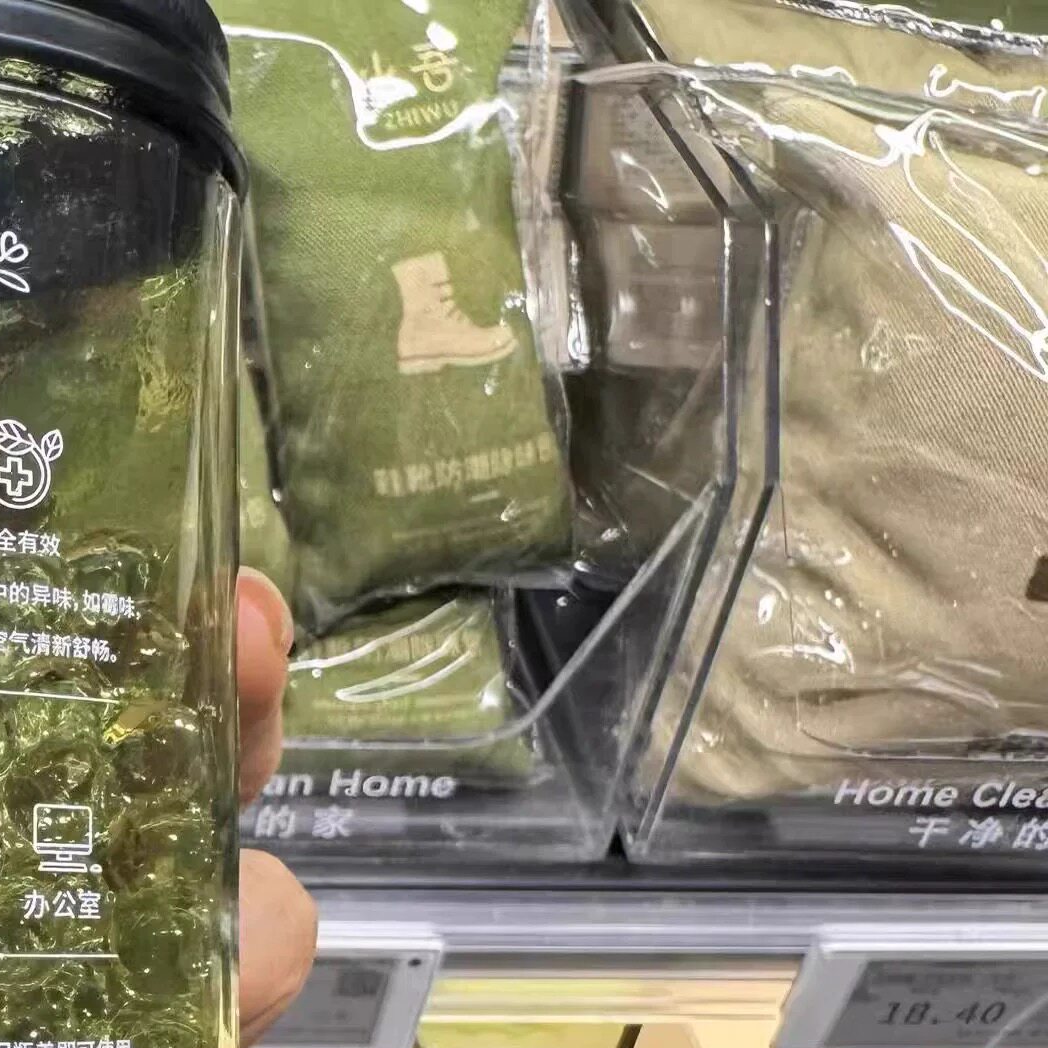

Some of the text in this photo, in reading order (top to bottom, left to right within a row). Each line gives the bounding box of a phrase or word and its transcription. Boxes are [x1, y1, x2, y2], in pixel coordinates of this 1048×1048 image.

[328, 768, 459, 798] Home
[833, 778, 959, 808] Home
[22, 889, 103, 920] 办公室
